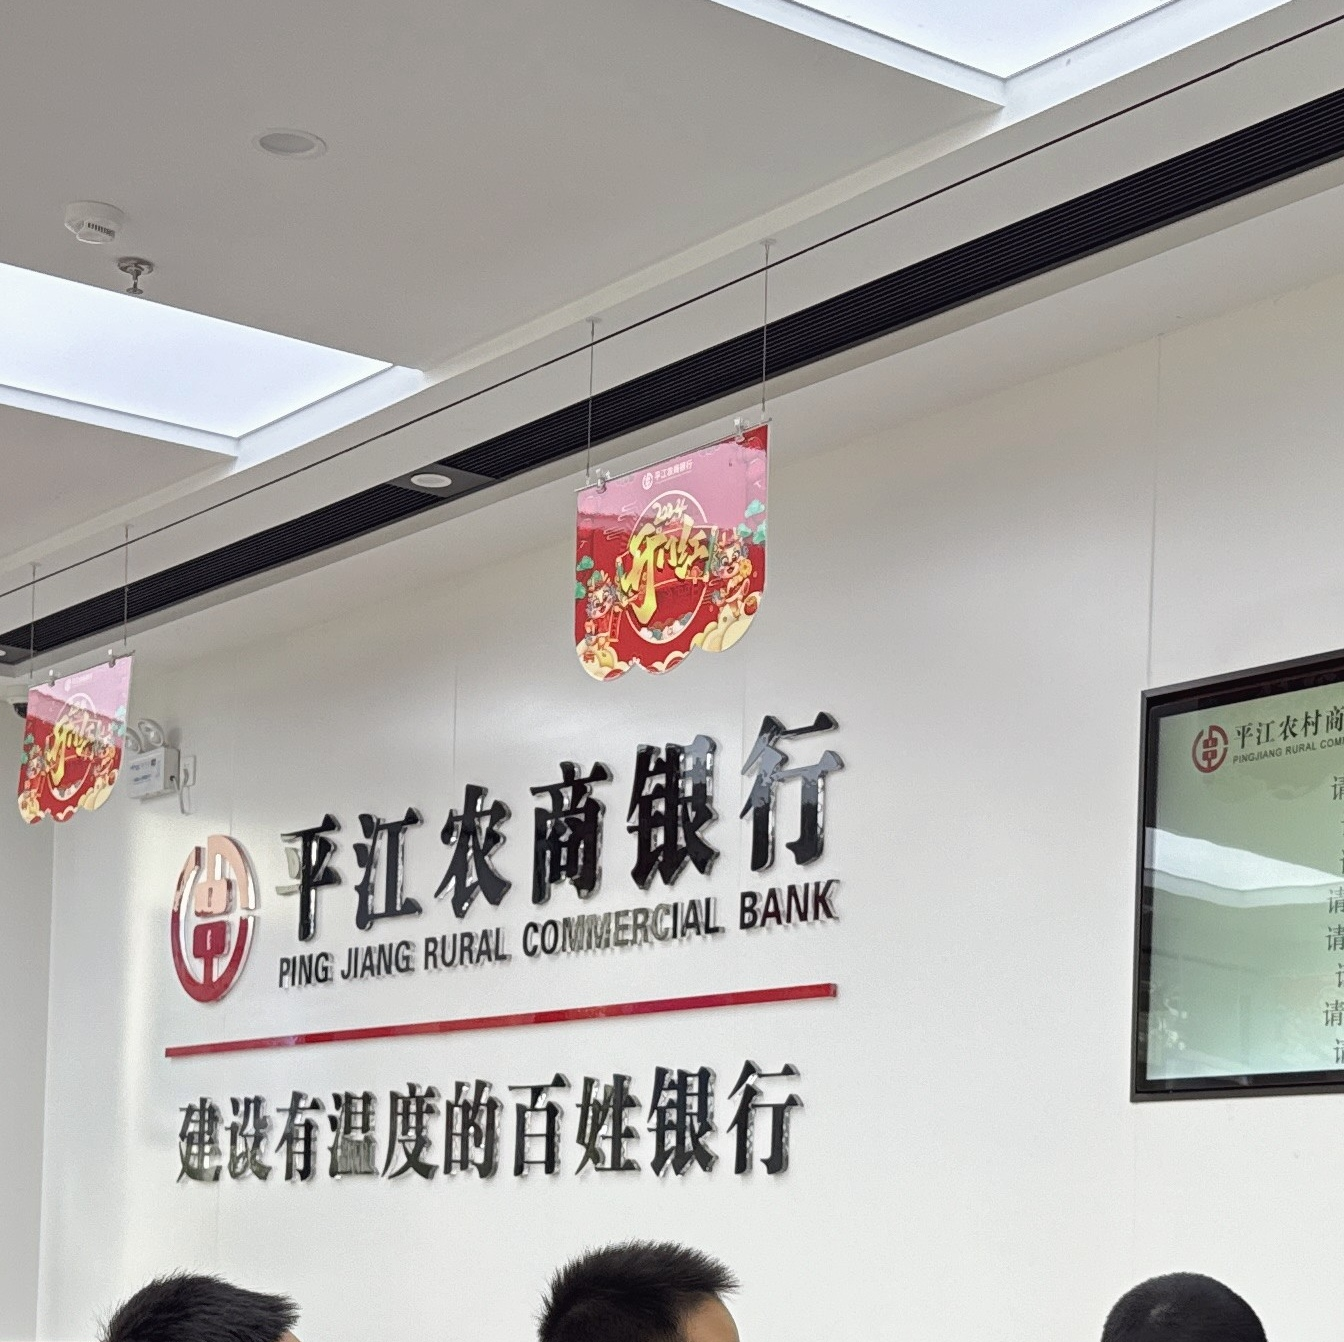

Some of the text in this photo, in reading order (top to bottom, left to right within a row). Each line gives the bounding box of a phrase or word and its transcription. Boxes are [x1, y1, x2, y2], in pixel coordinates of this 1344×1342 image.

[1232, 748, 1283, 764] PINGJIANG
[1285, 741, 1317, 756] RURAL
[276, 711, 846, 941] 平江农商银行
[279, 878, 842, 989] PING JIANG RURAL COMMERCIAL BANK
[175, 1058, 804, 1184] 建设有温度的百姓银行
